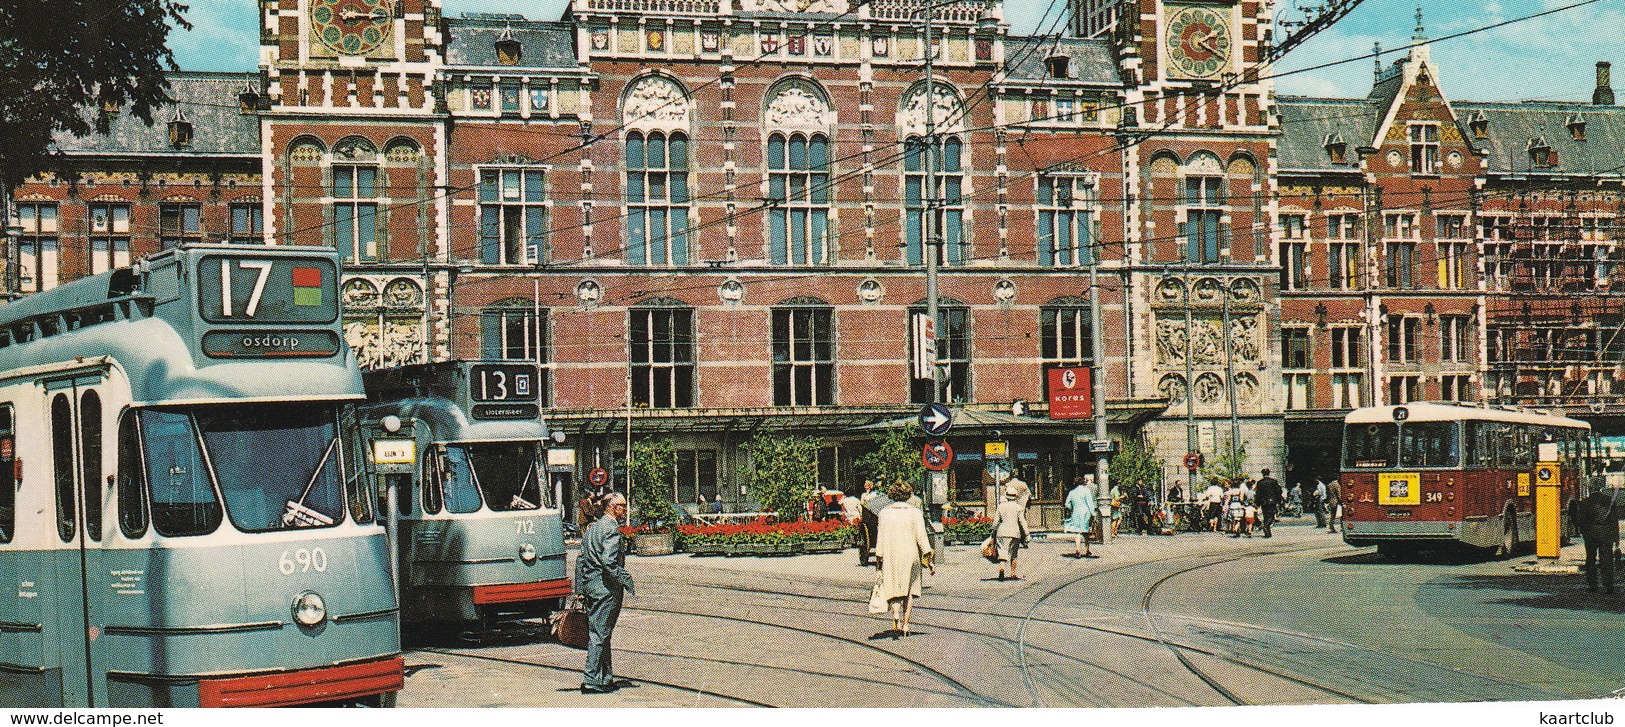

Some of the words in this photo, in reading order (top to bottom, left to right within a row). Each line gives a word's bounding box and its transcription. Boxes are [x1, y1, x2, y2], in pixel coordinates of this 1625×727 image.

[221, 258, 273, 317] 17
[243, 333, 299, 350] osdorp
[481, 370, 508, 400] 13
[1426, 492, 1443, 503] 349
[515, 520, 536, 536] 712
[279, 546, 327, 576] 690
